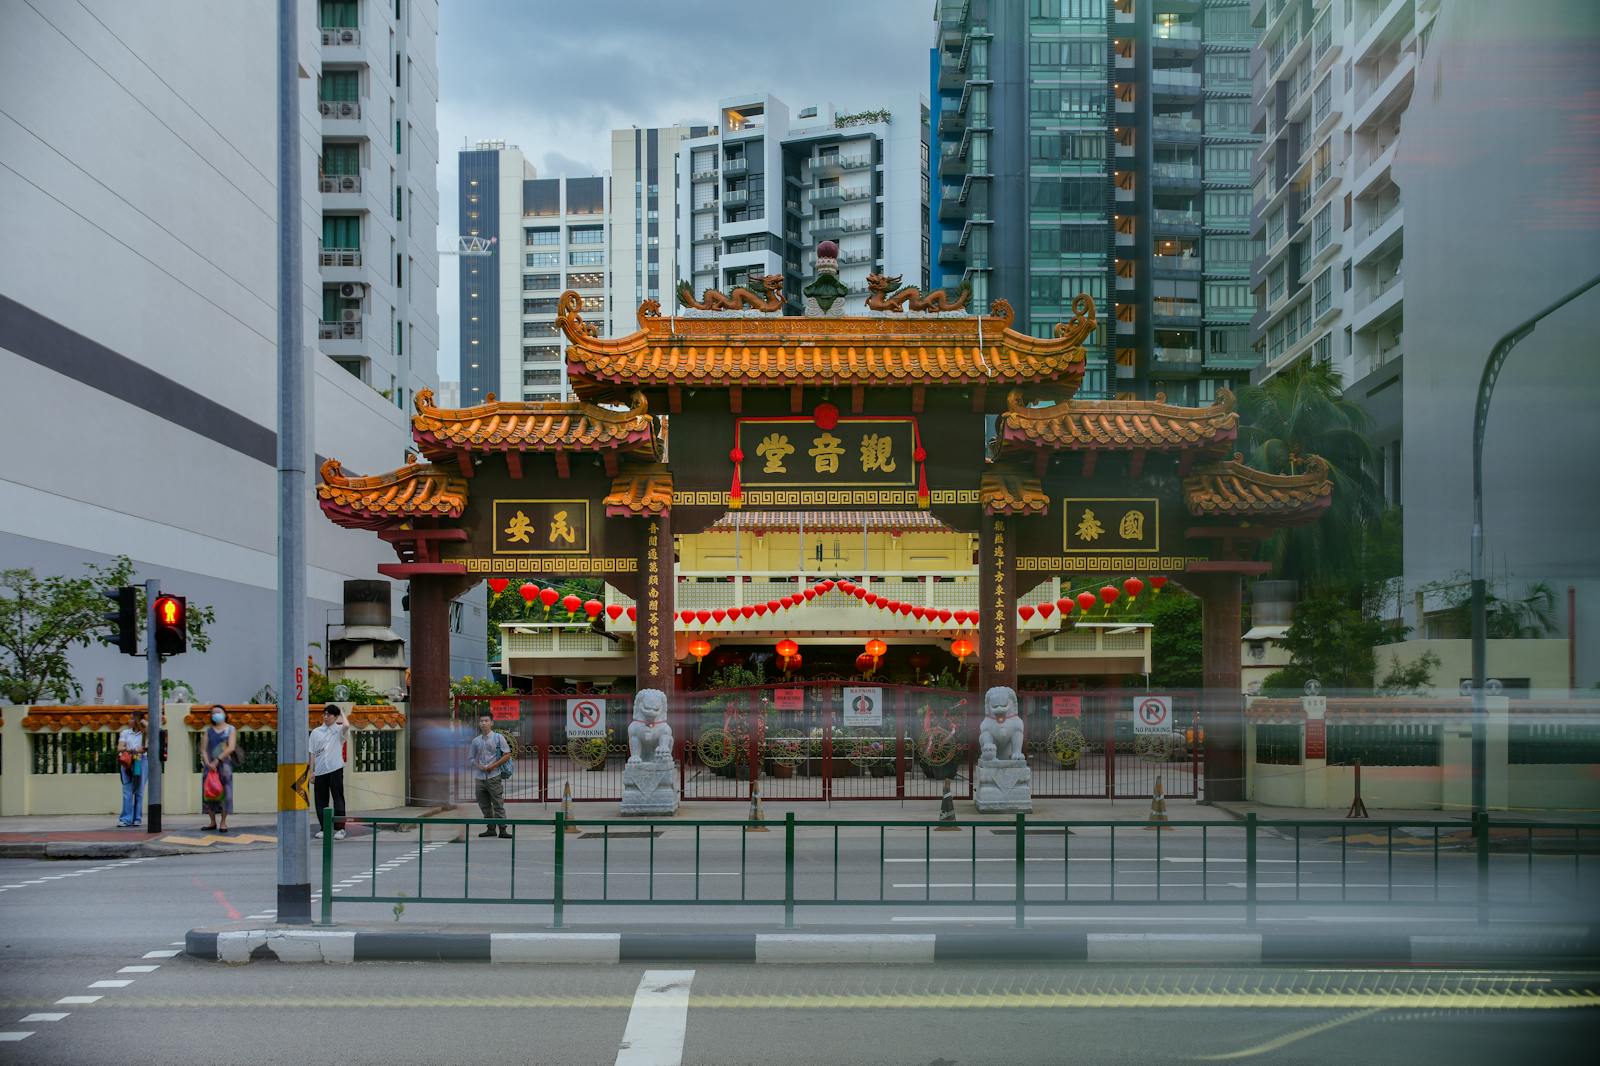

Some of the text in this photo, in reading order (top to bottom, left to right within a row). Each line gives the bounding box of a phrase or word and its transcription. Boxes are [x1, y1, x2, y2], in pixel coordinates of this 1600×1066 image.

[756, 432, 897, 474] 觀音堂
[504, 510, 576, 544] 民安
[1075, 508, 1145, 542] 國泰
[295, 667, 304, 701] 62
